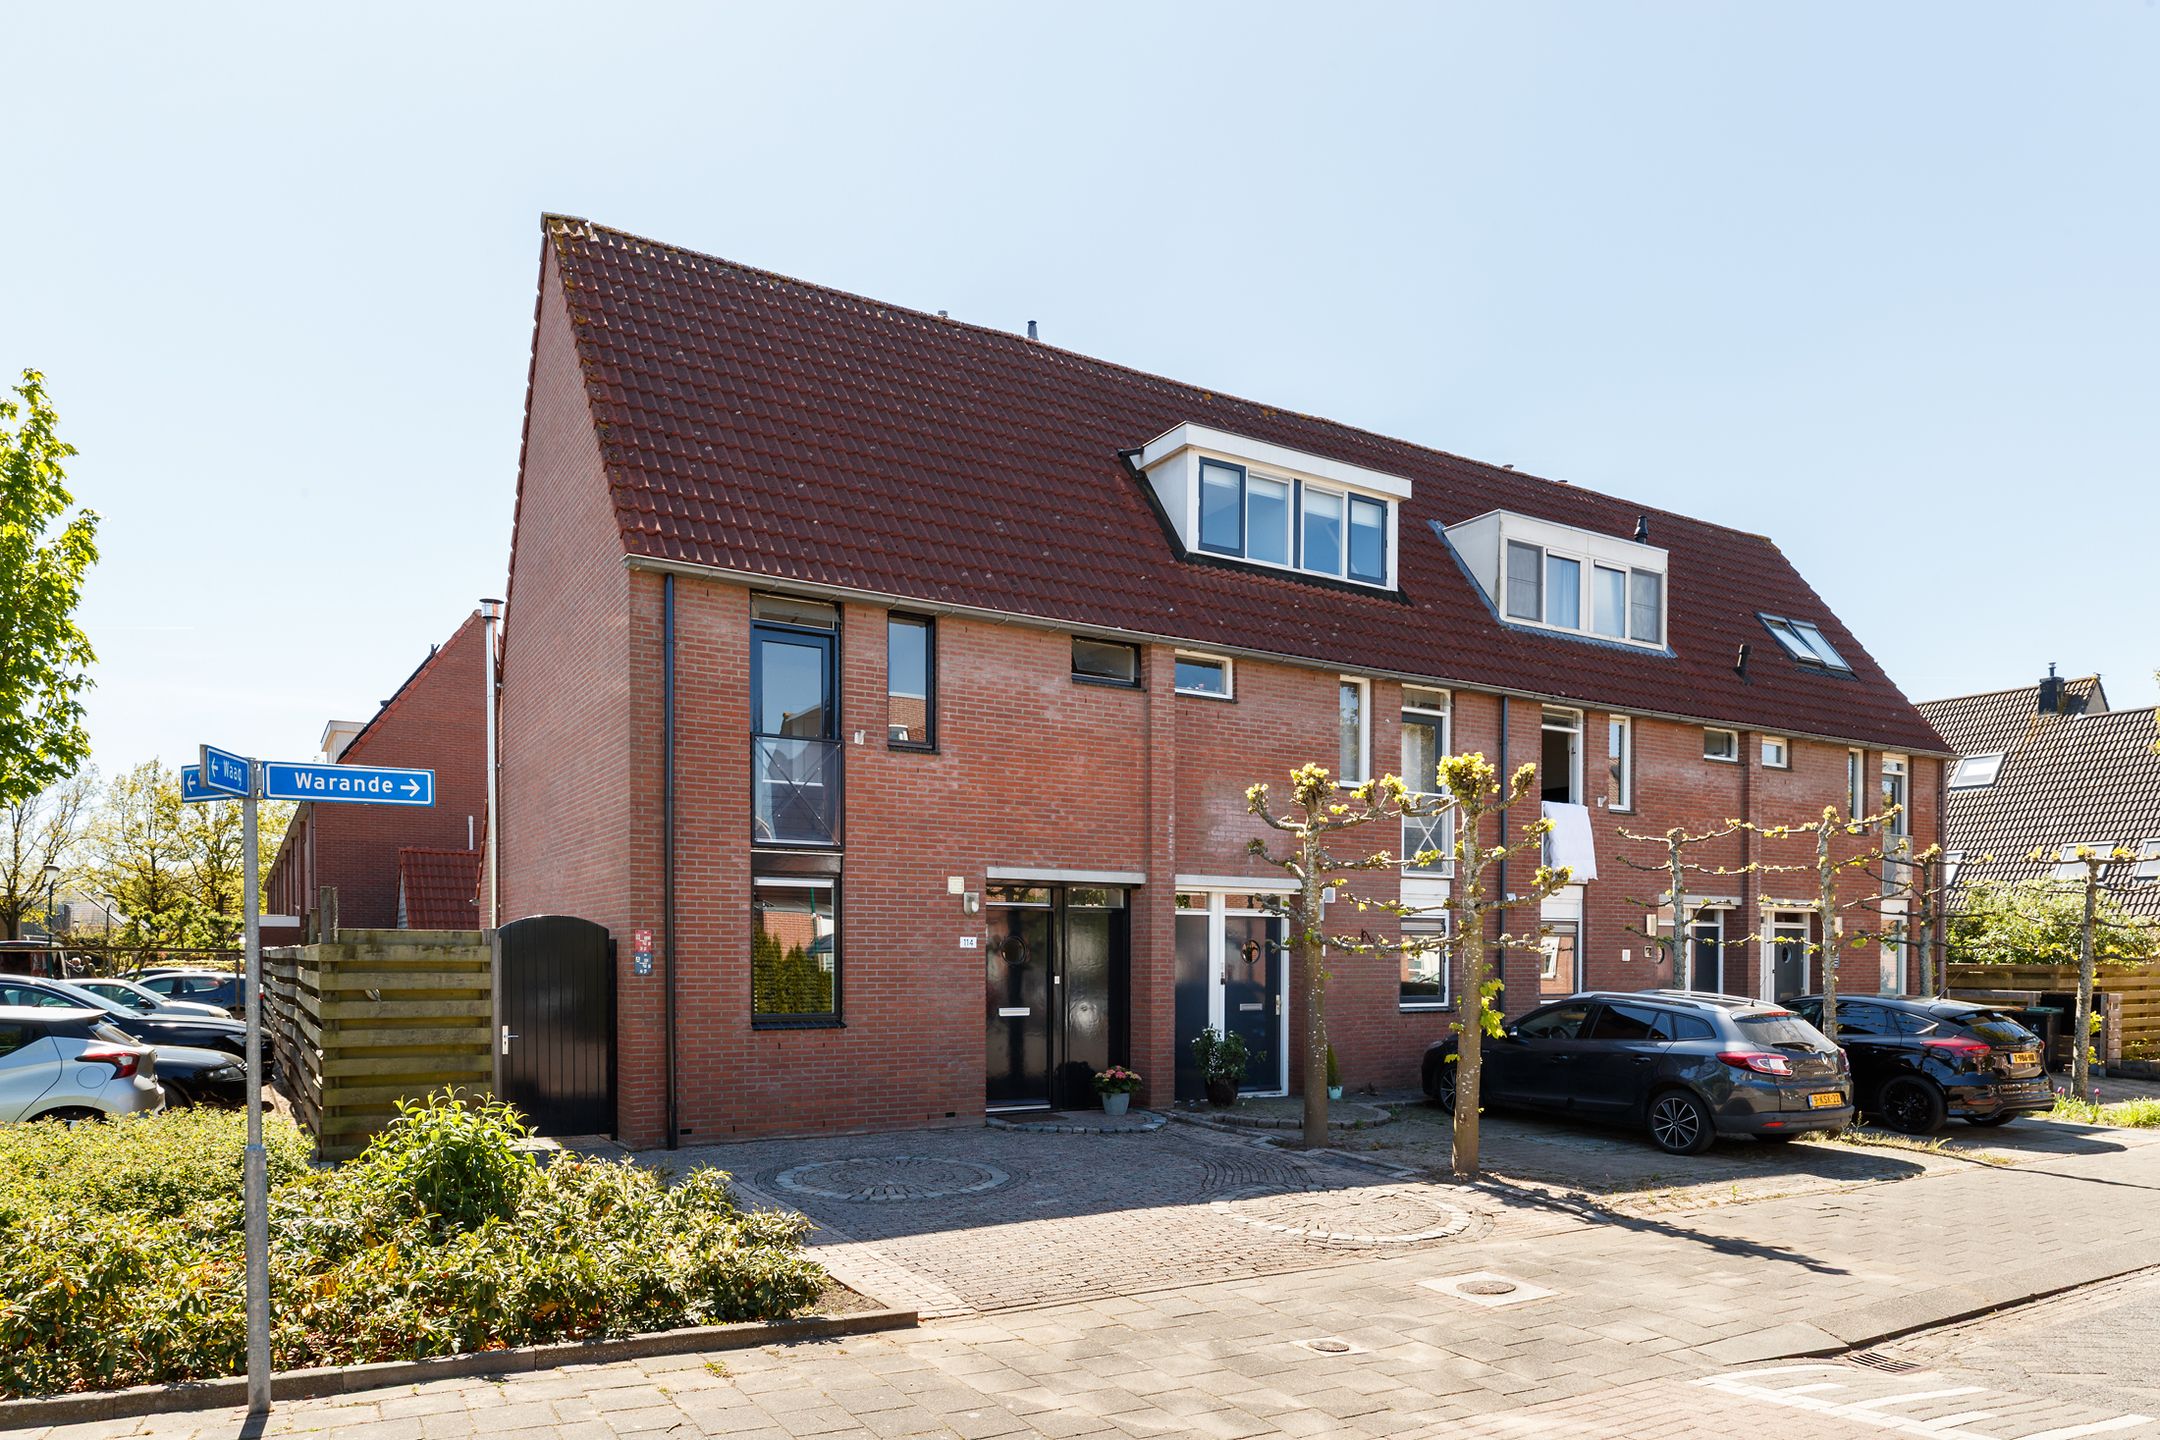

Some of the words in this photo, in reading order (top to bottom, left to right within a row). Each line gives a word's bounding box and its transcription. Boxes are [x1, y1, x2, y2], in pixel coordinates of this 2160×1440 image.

[223, 760, 242, 787] Waag
[294, 772, 393, 793] Warande
[963, 938, 974, 947] 114
